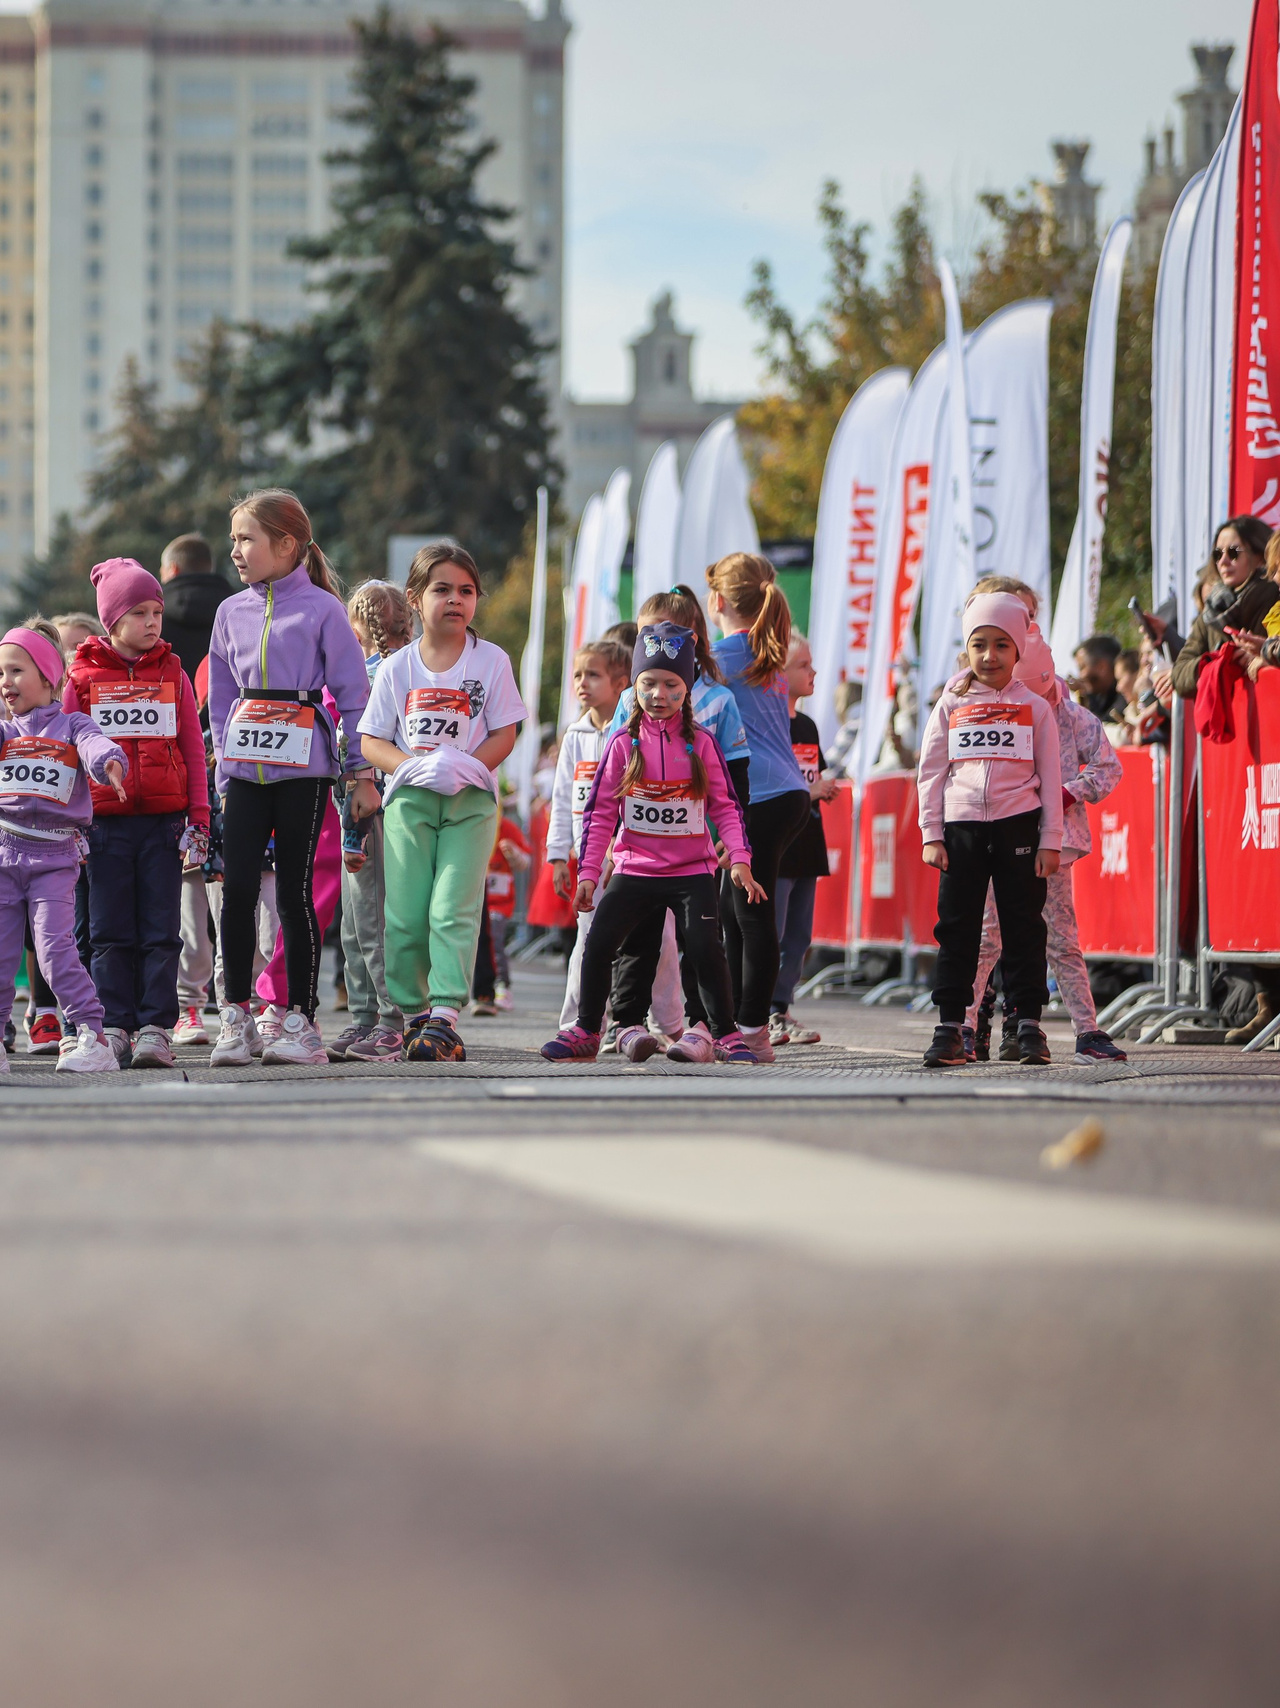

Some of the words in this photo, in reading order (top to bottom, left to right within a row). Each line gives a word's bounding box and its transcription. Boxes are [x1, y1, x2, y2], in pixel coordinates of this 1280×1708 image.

[847, 480, 877, 650] МАГНИТ
[99, 709, 159, 726] 3020
[409, 717, 459, 738] 3274
[237, 729, 289, 749] 3127
[958, 730, 1015, 747] 3292
[1, 764, 60, 787] 3062
[632, 803, 688, 824] 3082
